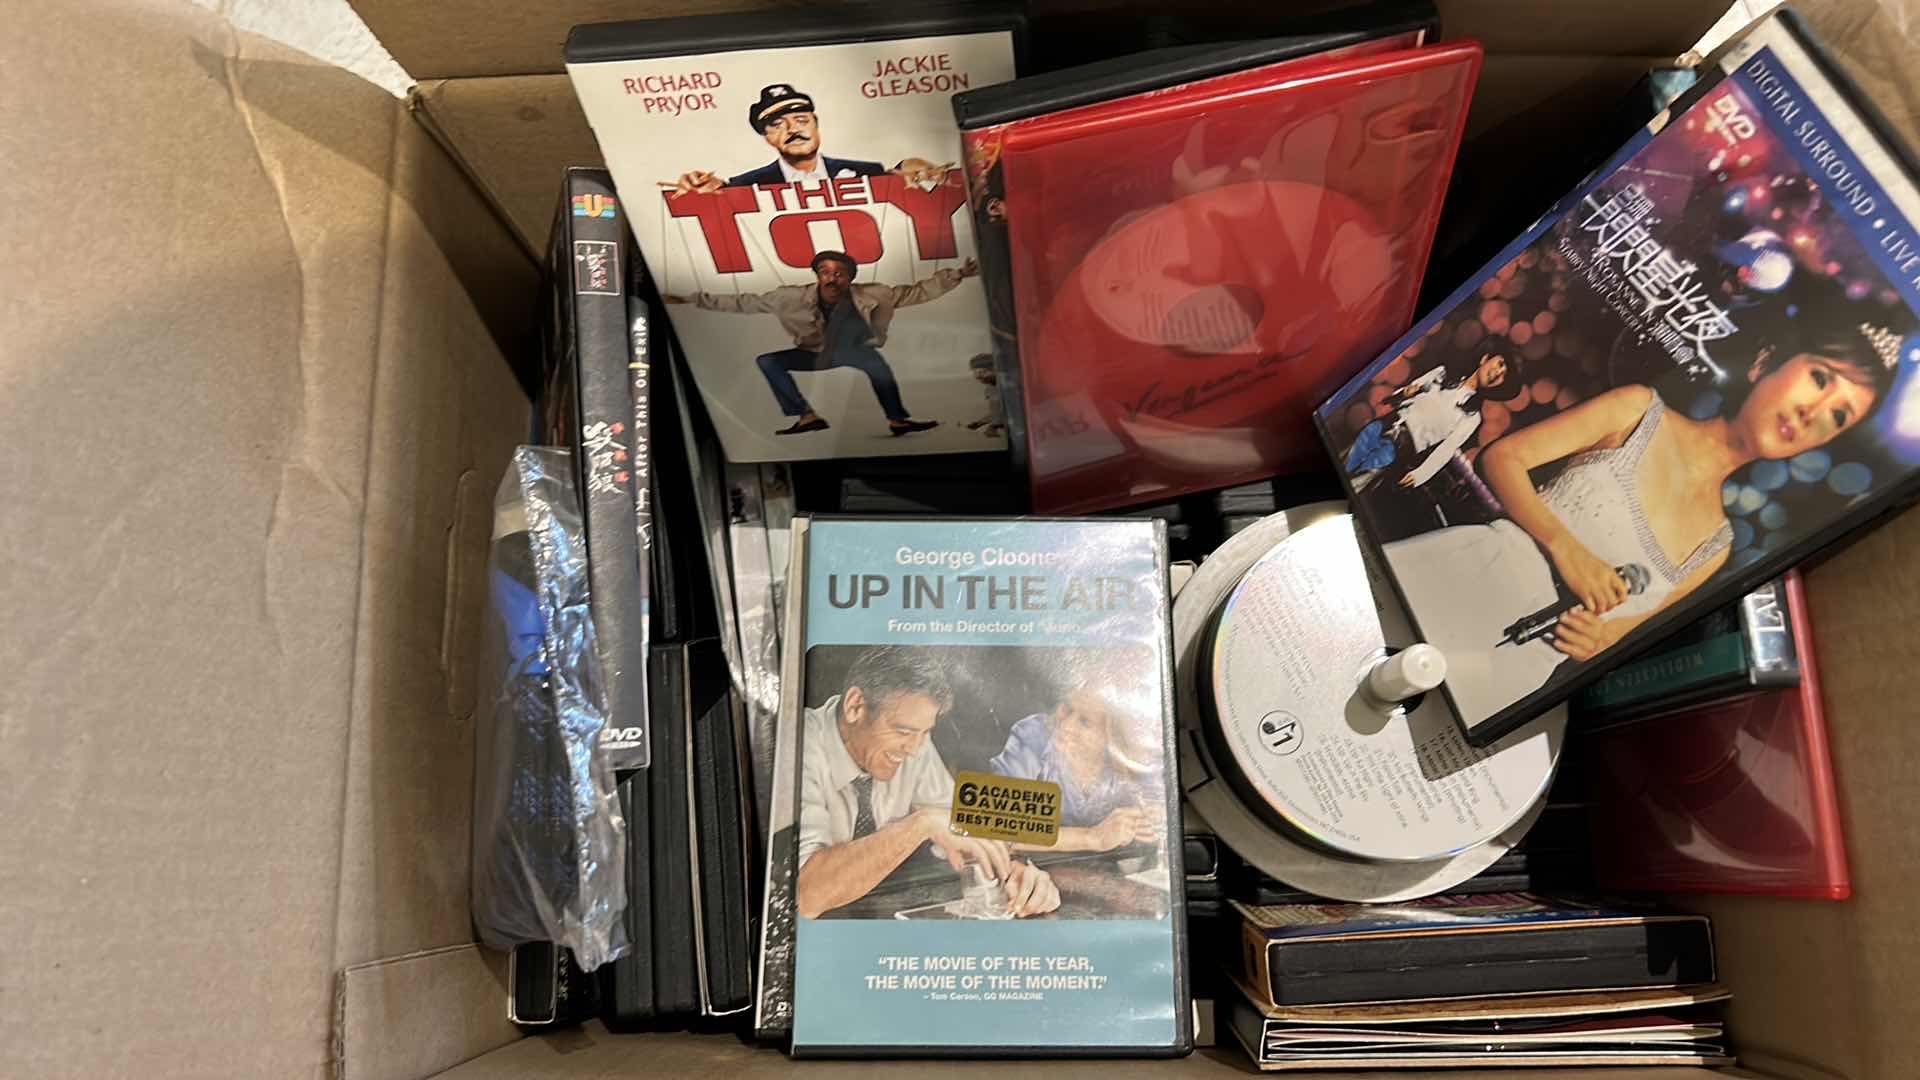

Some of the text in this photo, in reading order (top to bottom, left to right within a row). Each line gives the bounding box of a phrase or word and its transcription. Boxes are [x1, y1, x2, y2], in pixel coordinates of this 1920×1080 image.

[872, 54, 953, 79] JACKIE
[623, 71, 723, 96] RICHARD
[861, 73, 970, 100] GLEASON
[1746, 58, 1920, 274] DIGITAL SURROUND LIVE
[755, 177, 870, 212] THE
[662, 168, 968, 274] TOY
[895, 545, 1068, 571] George Cloone
[828, 574, 1137, 611] UP IN THE AIR
[887, 619, 926, 633] From
[930, 619, 952, 633] the
[955, 619, 1015, 633] Director
[1018, 619, 1034, 633] of
[959, 782, 1056, 807] 6 ACADEMY
[978, 797, 1057, 817] AWARD
[955, 812, 992, 827] BEST
[994, 816, 1055, 835] PICTURE
[924, 956, 978, 972] MOVIE
[981, 956, 1005, 972] OF
[1007, 956, 1041, 972] THE
[1045, 956, 1095, 974] YEAR,
[864, 975, 900, 990] THE
[903, 975, 957, 990] MOVIE
[960, 975, 985, 990] OF
[988, 975, 1021, 990] THE
